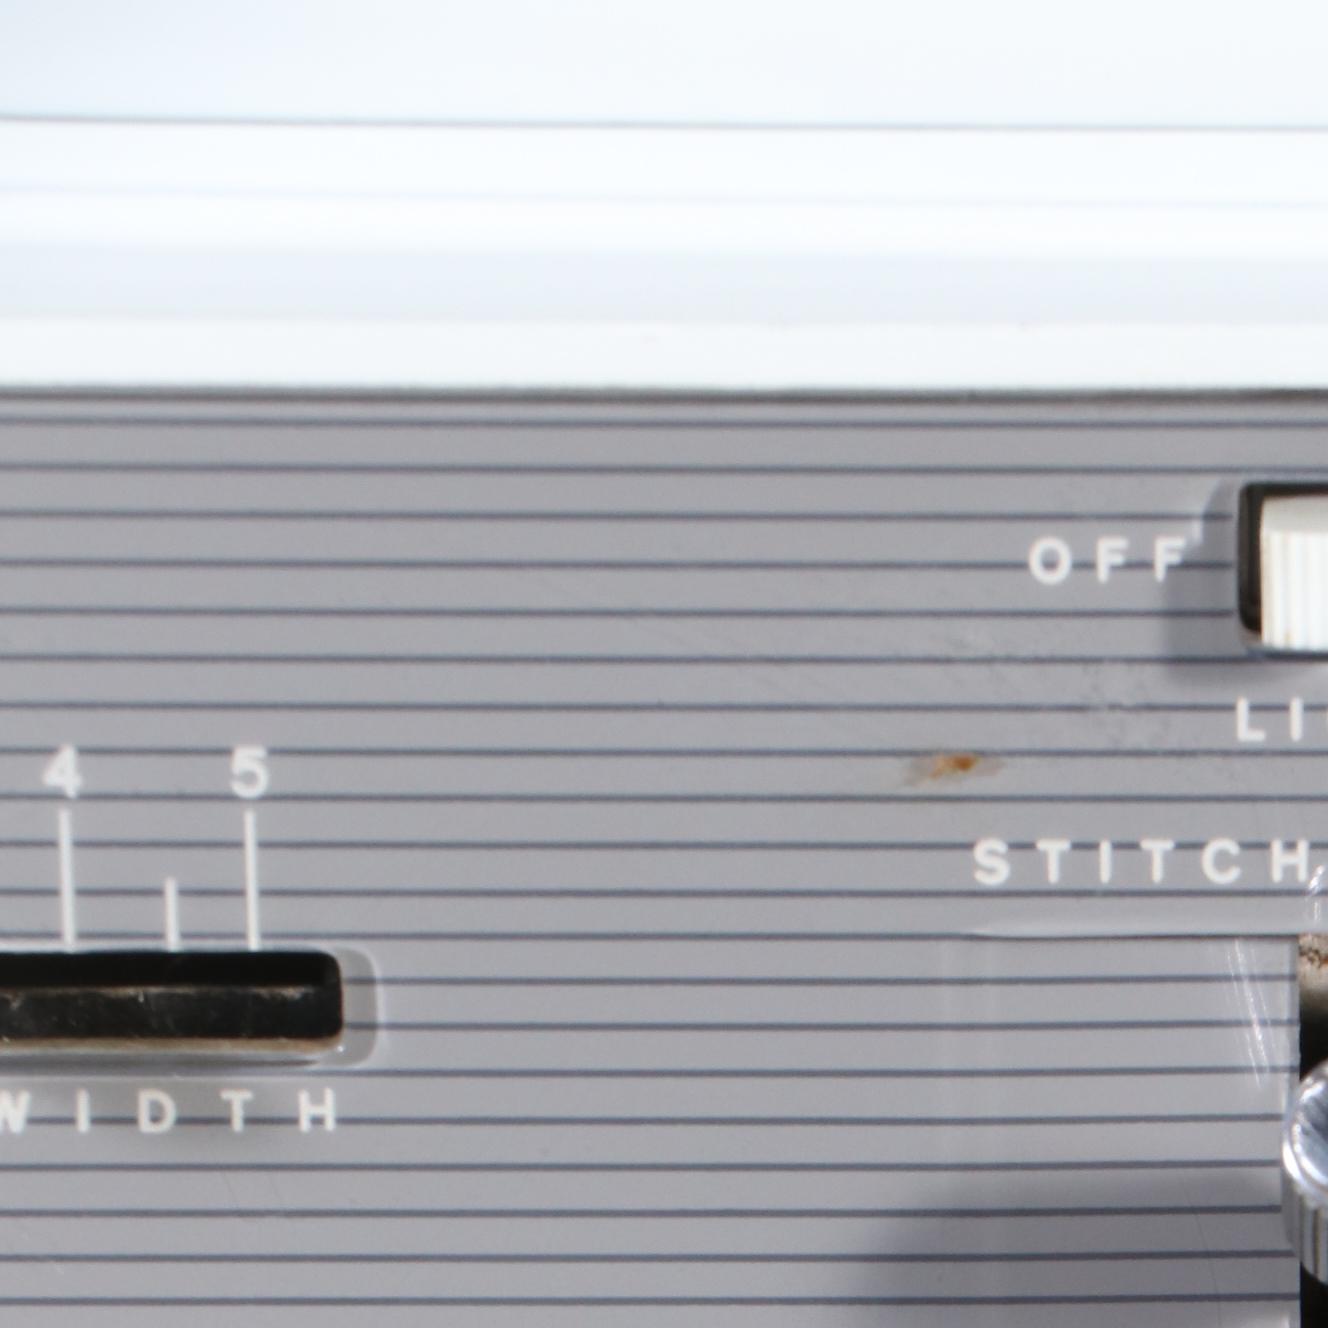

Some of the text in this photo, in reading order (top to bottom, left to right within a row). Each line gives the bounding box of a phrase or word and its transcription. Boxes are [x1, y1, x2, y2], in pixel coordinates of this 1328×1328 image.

[1028, 535, 1187, 586] OFF
[42, 745, 269, 798] 4 5
[973, 837, 1309, 886] STITCH
